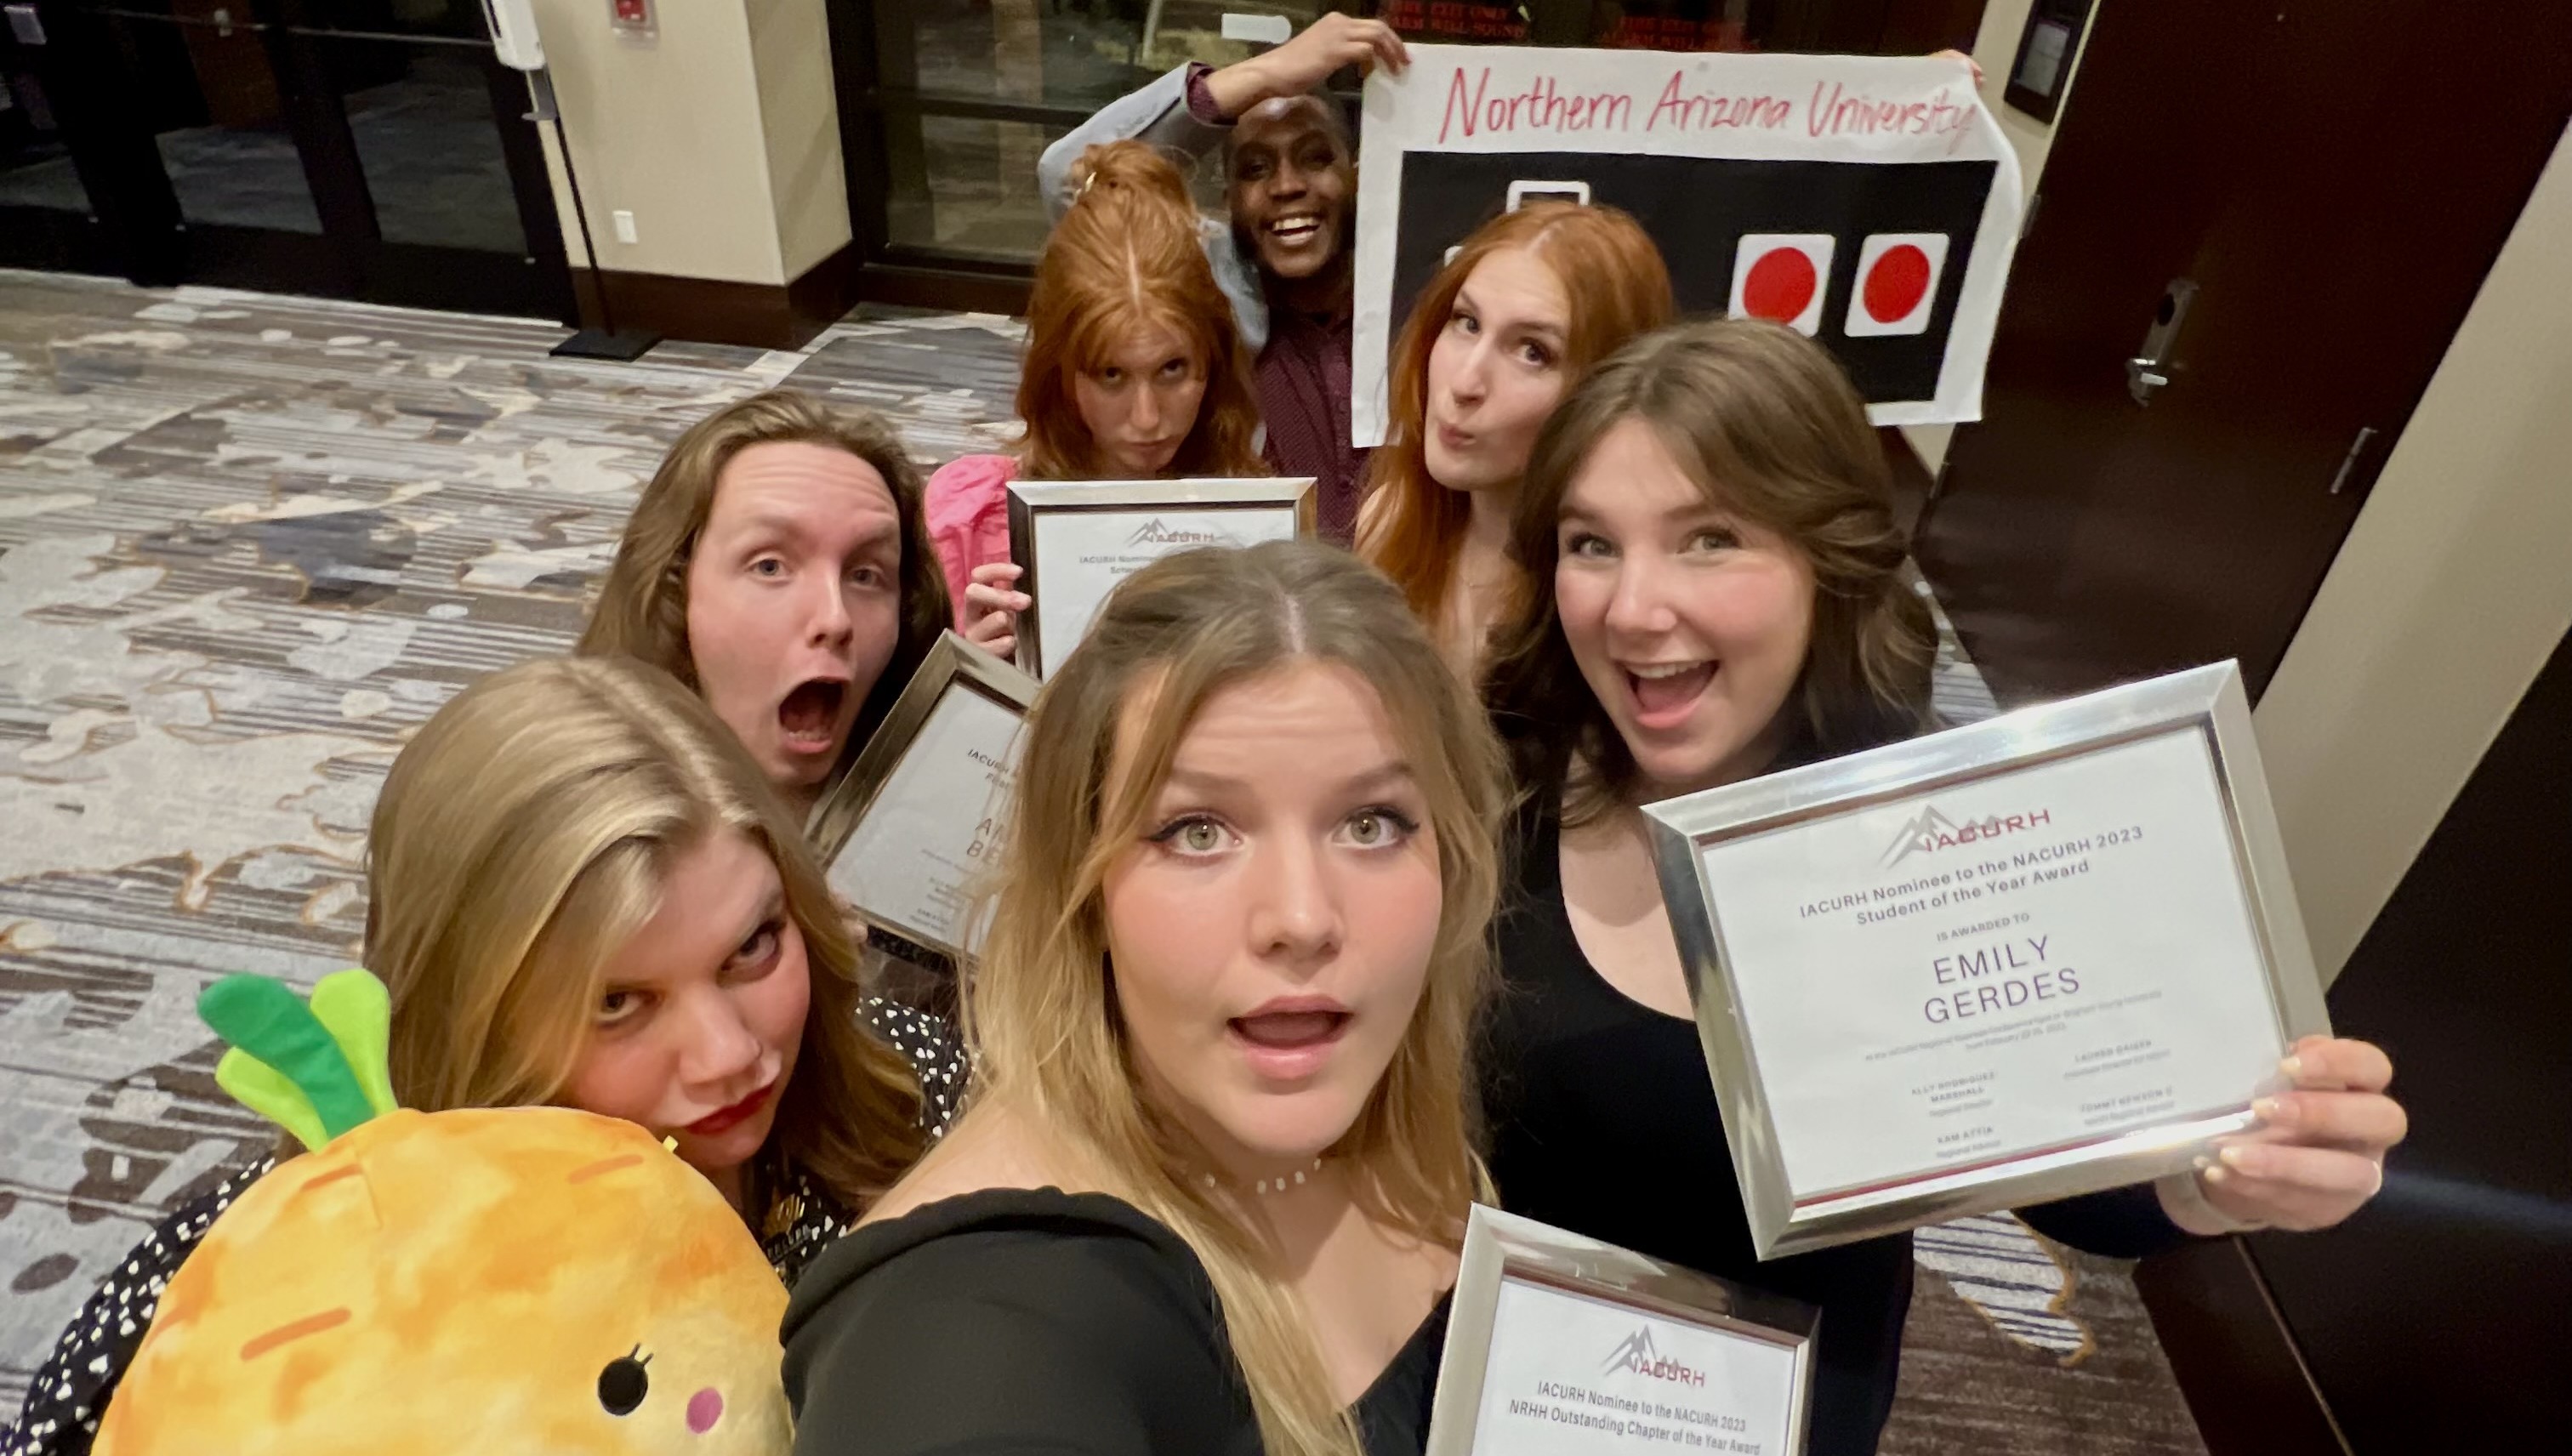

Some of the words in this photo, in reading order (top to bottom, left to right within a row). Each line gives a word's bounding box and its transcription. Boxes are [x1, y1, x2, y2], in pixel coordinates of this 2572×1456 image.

[1438, 67, 1632, 145] Northern
[1646, 70, 1792, 132] Arizona
[1807, 80, 1979, 156] University
[1799, 891, 1869, 919] IACURH
[1873, 873, 1951, 901] Nominee
[1955, 867, 1974, 882] to
[1978, 858, 2008, 877] the
[2012, 839, 2091, 868] NACURH
[2096, 825, 2143, 849] 2023
[1857, 899, 1926, 926] Student
[1931, 893, 1948, 908] of
[1953, 885, 1983, 903] the
[1986, 875, 2028, 895] Year
[2033, 859, 2090, 885] Award
[1936, 932, 1949, 942] IS
[1951, 916, 2011, 939] AWARDED
[2012, 912, 2030, 924] TO
[1932, 934, 2048, 985] EMILY
[1924, 967, 2080, 1024] GERDES
[1509, 1398, 1548, 1419] NRHH
[1551, 1407, 1625, 1436] Outstanding
[1627, 1420, 1671, 1441] Chapter
[1672, 1428, 1684, 1443] of
[1685, 1430, 1703, 1447] the
[1705, 1434, 1728, 1451] Year
[1729, 1438, 1762, 1456] Award
[1537, 1379, 1585, 1402] IACURH
[1588, 1390, 1639, 1413] Nominee
[1641, 1401, 1653, 1415] to
[1654, 1403, 1672, 1419] the
[1674, 1407, 1719, 1428] NACURH
[1720, 1415, 1747, 1433] 2023
